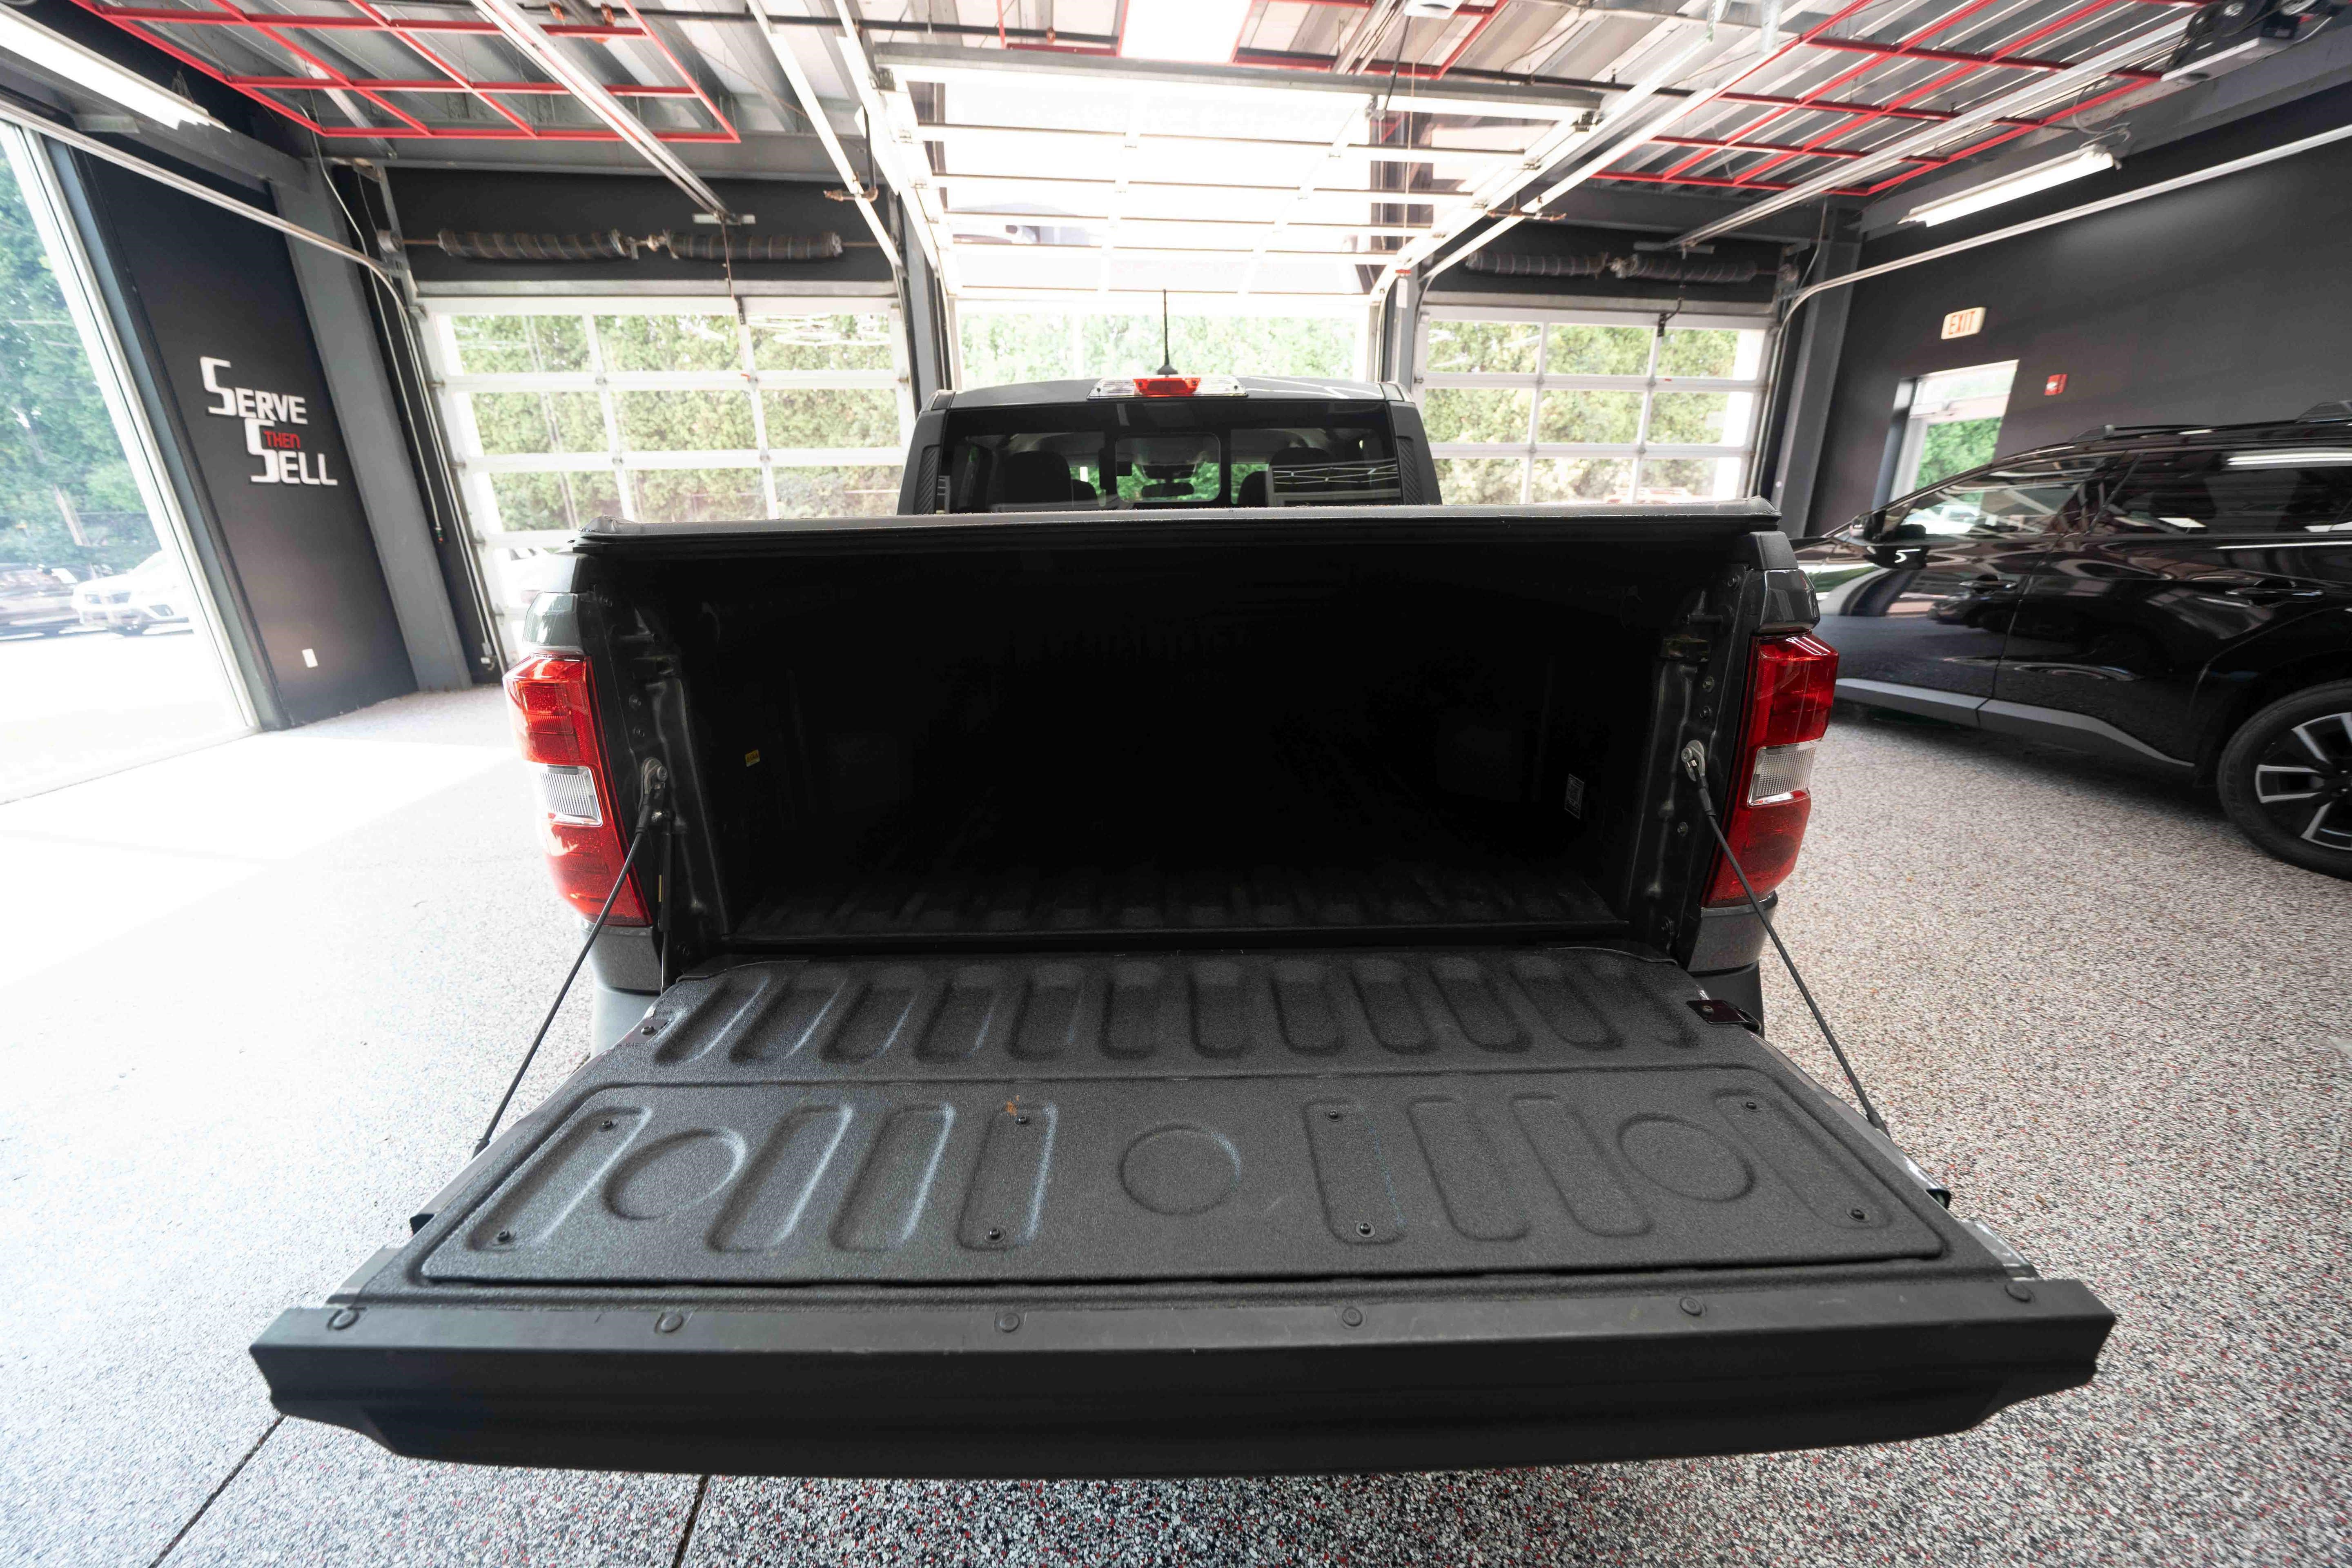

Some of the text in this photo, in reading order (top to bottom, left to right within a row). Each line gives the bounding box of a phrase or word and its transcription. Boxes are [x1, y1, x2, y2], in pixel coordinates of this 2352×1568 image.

[1948, 310, 1976, 335] EXIT
[200, 356, 308, 424] SERVE
[245, 418, 338, 486] SELL
[263, 430, 301, 449] THEN
